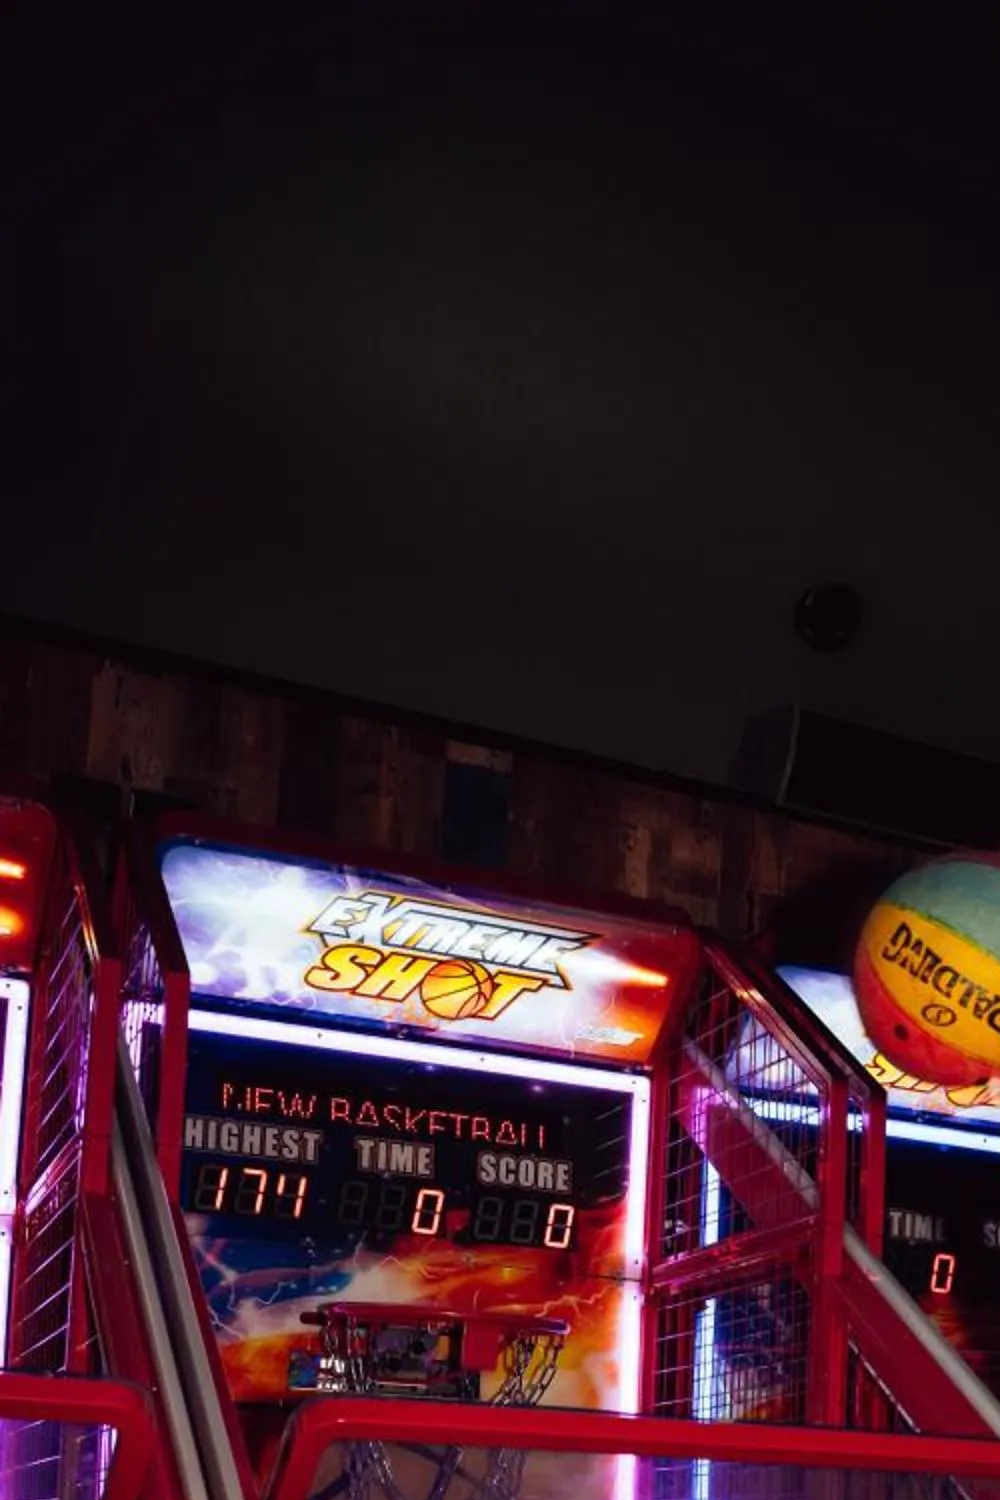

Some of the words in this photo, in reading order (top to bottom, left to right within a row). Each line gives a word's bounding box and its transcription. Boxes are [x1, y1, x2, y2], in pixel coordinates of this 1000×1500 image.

[307, 891, 603, 990] EXTREME
[304, 944, 548, 1021] SHOT
[183, 1116, 322, 1162] HIGHEST
[355, 1137, 434, 1177] TIME
[214, 1167, 308, 1219] 174
[478, 1152, 572, 1193] SCORE
[411, 1188, 446, 1236] 0
[543, 1203, 576, 1249] 0
[930, 1253, 956, 1294] 0
